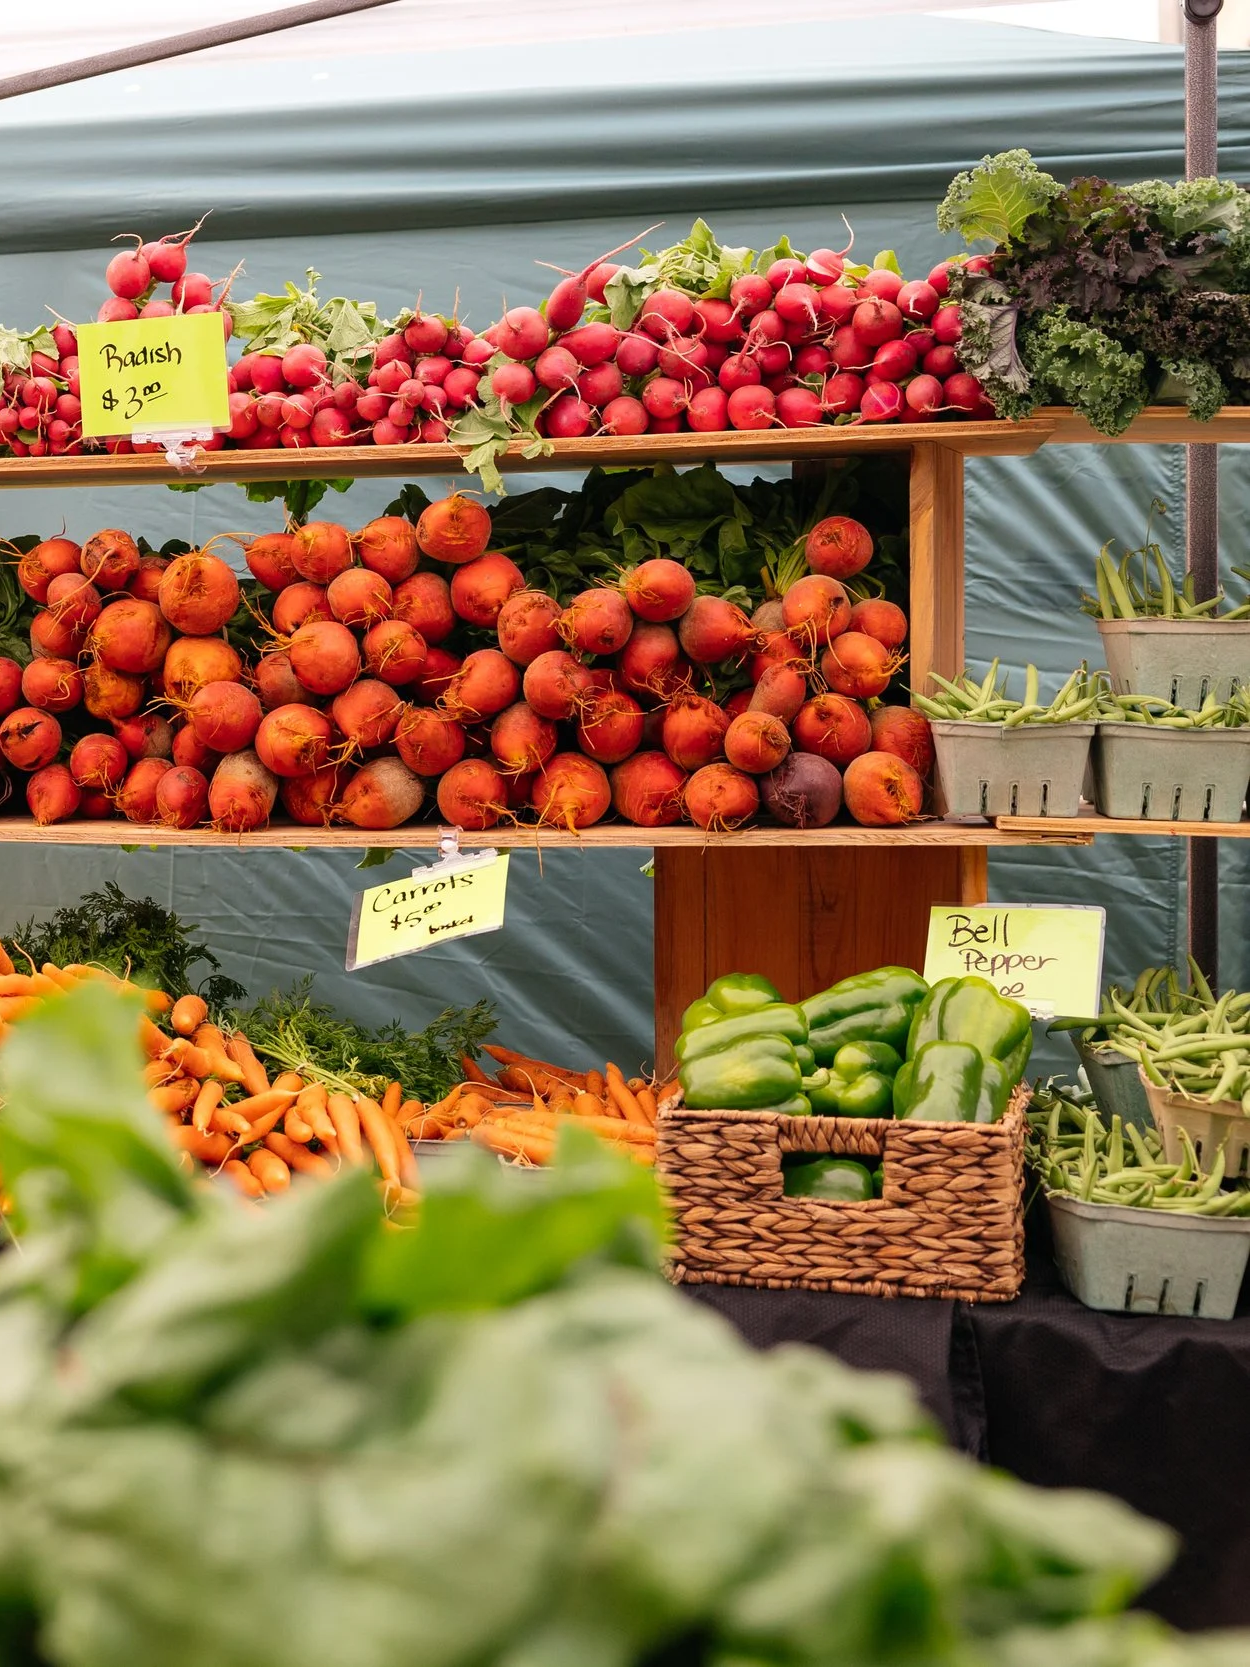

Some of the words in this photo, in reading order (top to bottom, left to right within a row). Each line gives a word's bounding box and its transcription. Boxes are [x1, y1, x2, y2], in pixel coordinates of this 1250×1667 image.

[99, 341, 182, 373] Radish
[372, 873, 474, 913] Carrots
[946, 912, 1009, 947] Bell
[958, 948, 1058, 977] Pepper
